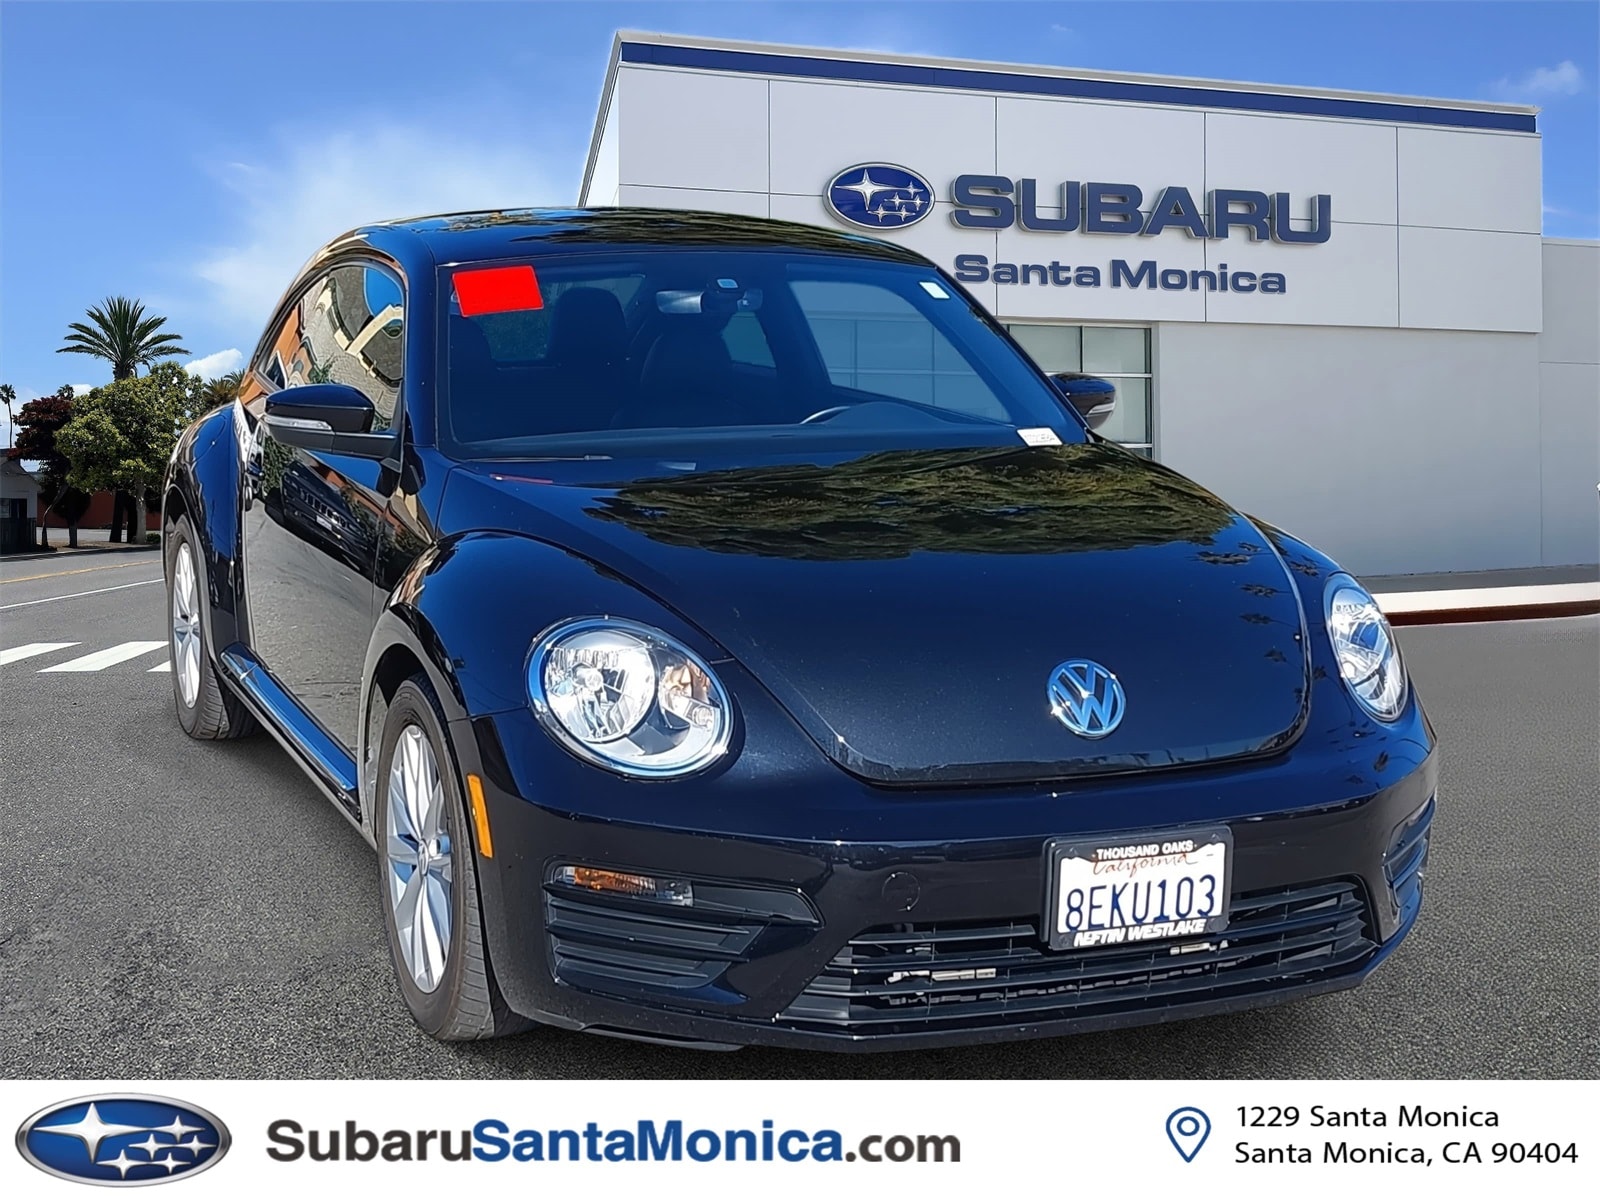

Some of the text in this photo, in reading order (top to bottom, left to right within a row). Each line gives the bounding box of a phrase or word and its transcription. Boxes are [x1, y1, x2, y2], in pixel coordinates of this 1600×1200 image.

[949, 174, 1332, 245] SUBARU
[954, 254, 1287, 294] Santa Monica
[1096, 839, 1194, 860] THOUSAND OAKS
[1065, 874, 1216, 931] 8EKU103
[1073, 918, 1207, 948] NEFTIN WESTLAKE
